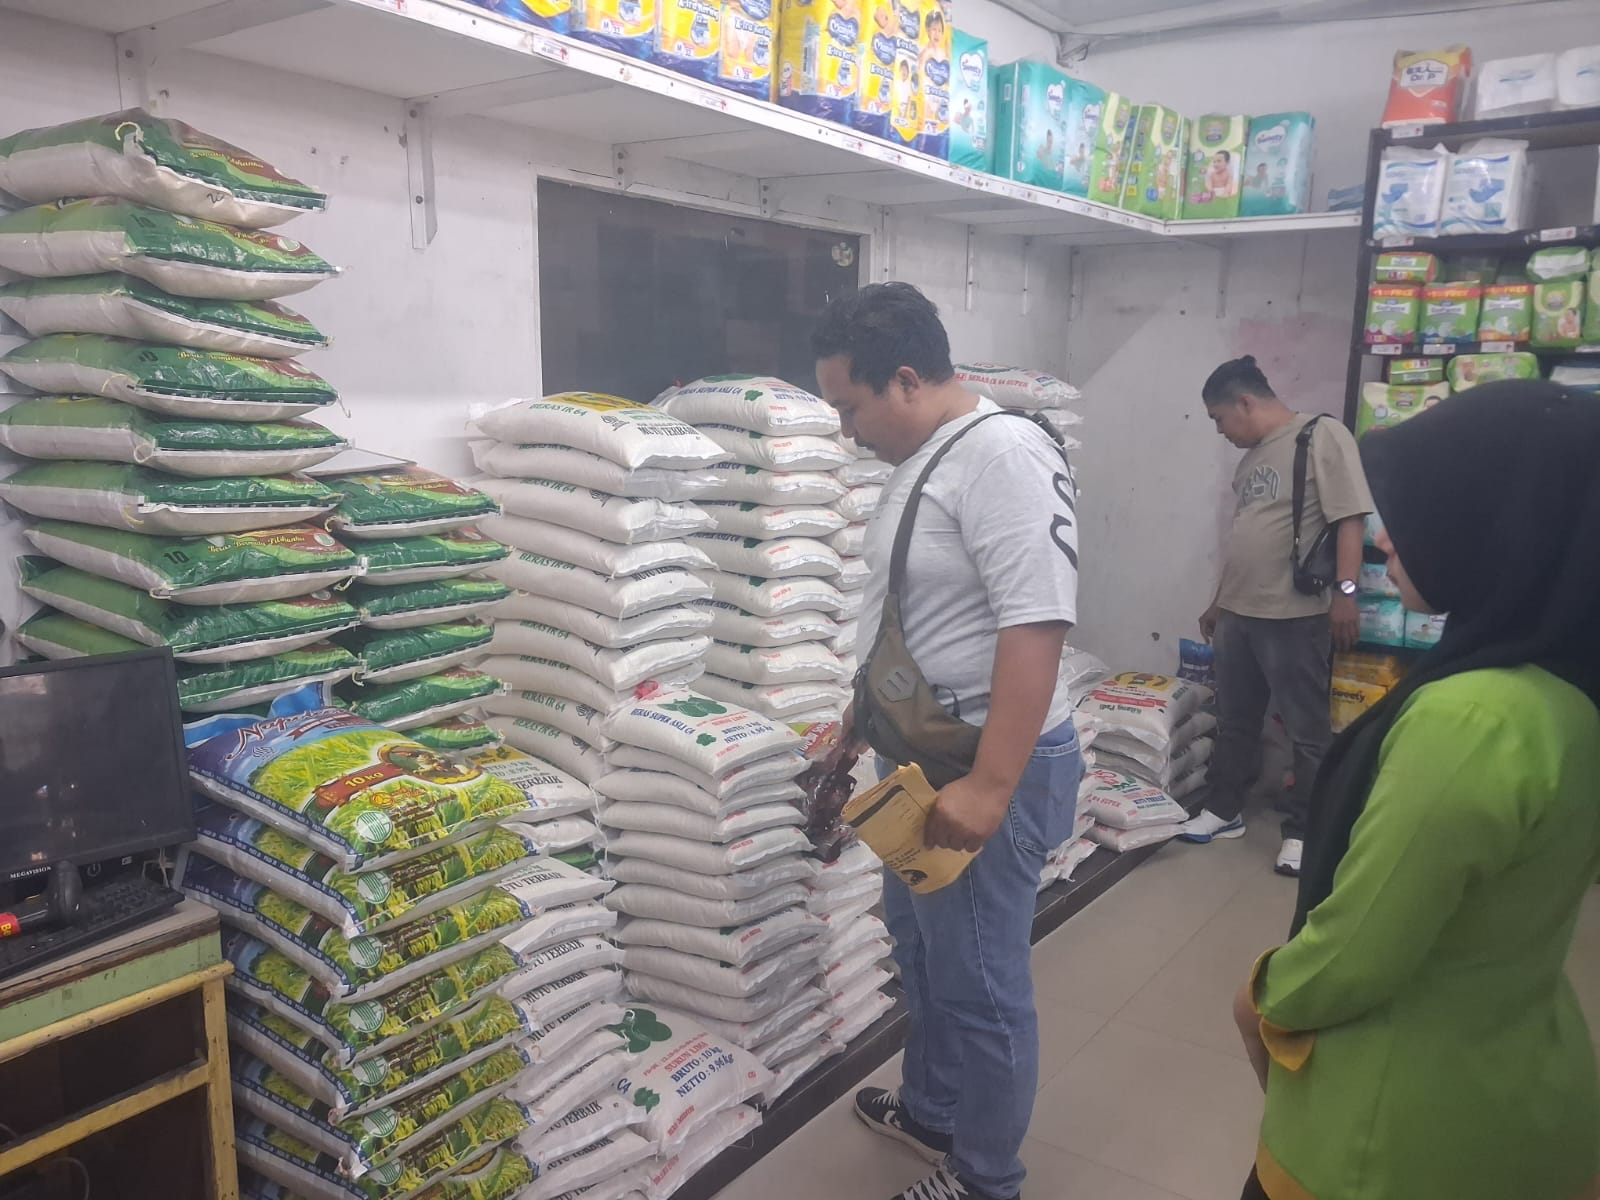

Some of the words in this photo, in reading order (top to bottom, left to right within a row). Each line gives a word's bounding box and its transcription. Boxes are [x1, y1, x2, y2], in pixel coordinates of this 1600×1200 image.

[163, 550, 190, 565] 10
[519, 552, 551, 567] BERAS
[1331, 687, 1366, 702] Sweety
[554, 703, 567, 713] 64
[648, 711, 672, 724] SUPER
[669, 718, 687, 731] ASLI
[345, 775, 365, 789] 10
[364, 770, 384, 782] kg
[512, 774, 564, 790] TERBAIK
[10, 865, 52, 879] MEGAVISION
[520, 871, 567, 886] TERBAIK
[542, 938, 585, 962] TERBAIK
[522, 981, 551, 1006] MUTU
[526, 1021, 557, 1043] MUTU
[670, 1058, 700, 1083] BRUTO
[701, 1049, 713, 1061] 10
[676, 1071, 708, 1098] NETTO
[560, 1099, 603, 1126] TERBAIK
